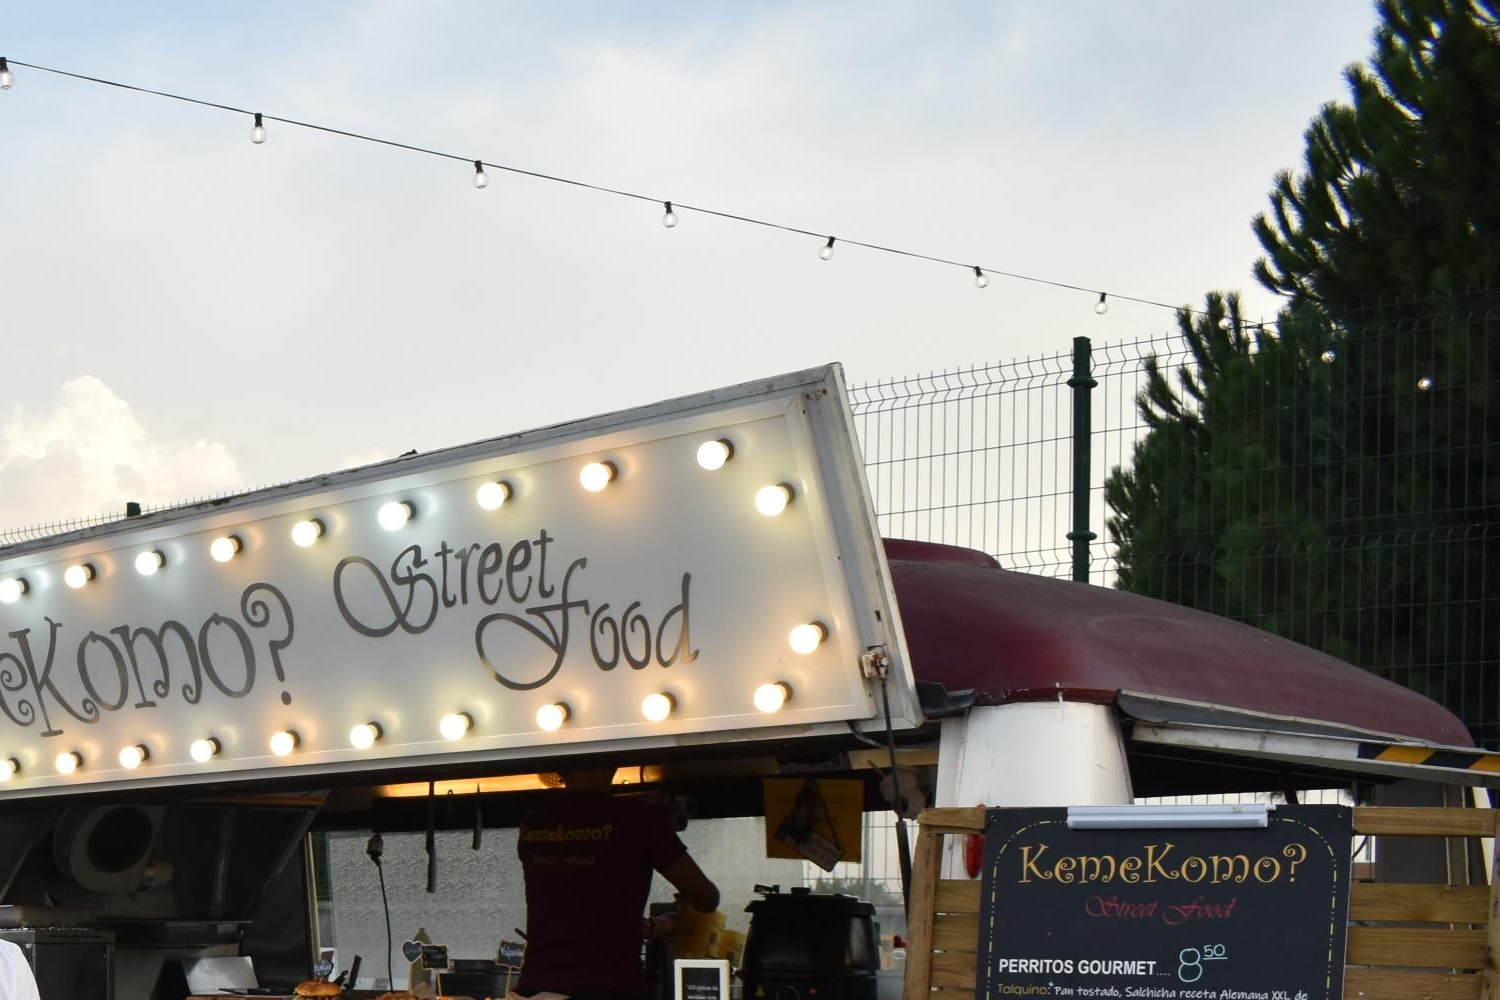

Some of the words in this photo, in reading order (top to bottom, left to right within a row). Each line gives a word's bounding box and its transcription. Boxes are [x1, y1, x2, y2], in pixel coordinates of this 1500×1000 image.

[333, 529, 554, 638] Street
[1019, 843, 1307, 883] KemeKomo?
[1085, 895, 1157, 918] Street
[1163, 896, 1236, 925] Food
[999, 959, 1073, 973] PERRITOS
[1055, 986, 1073, 995] Pan
[1077, 986, 1121, 998] tostado,
[1125, 986, 1175, 998] Salchicha
[1180, 990, 1216, 998] receta
[1220, 989, 1268, 1000] Alemana
[1272, 990, 1291, 1000] XXL
[1295, 990, 1308, 1000] de
